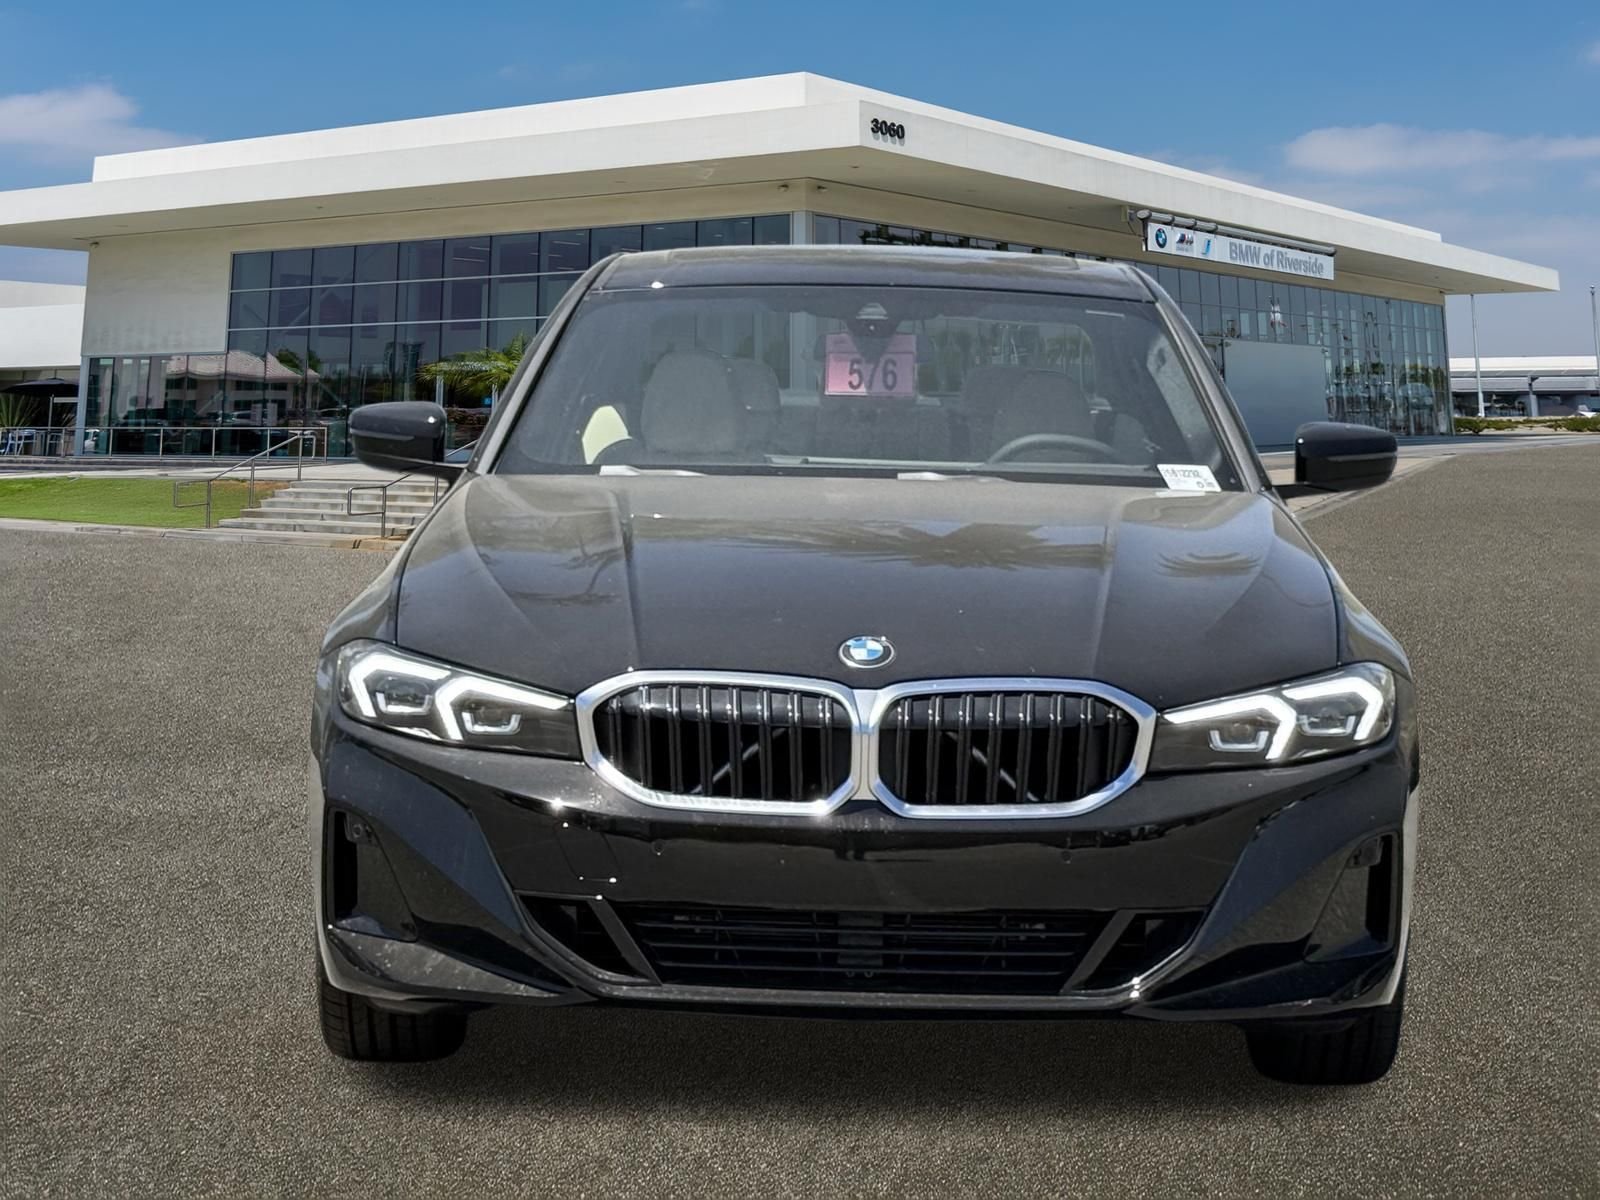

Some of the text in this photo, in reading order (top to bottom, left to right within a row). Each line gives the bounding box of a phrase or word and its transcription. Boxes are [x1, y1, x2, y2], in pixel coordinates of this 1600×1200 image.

[870, 118, 905, 139] 3060
[1229, 242, 1324, 275] BMW of Riverside
[848, 358, 898, 390] 576
